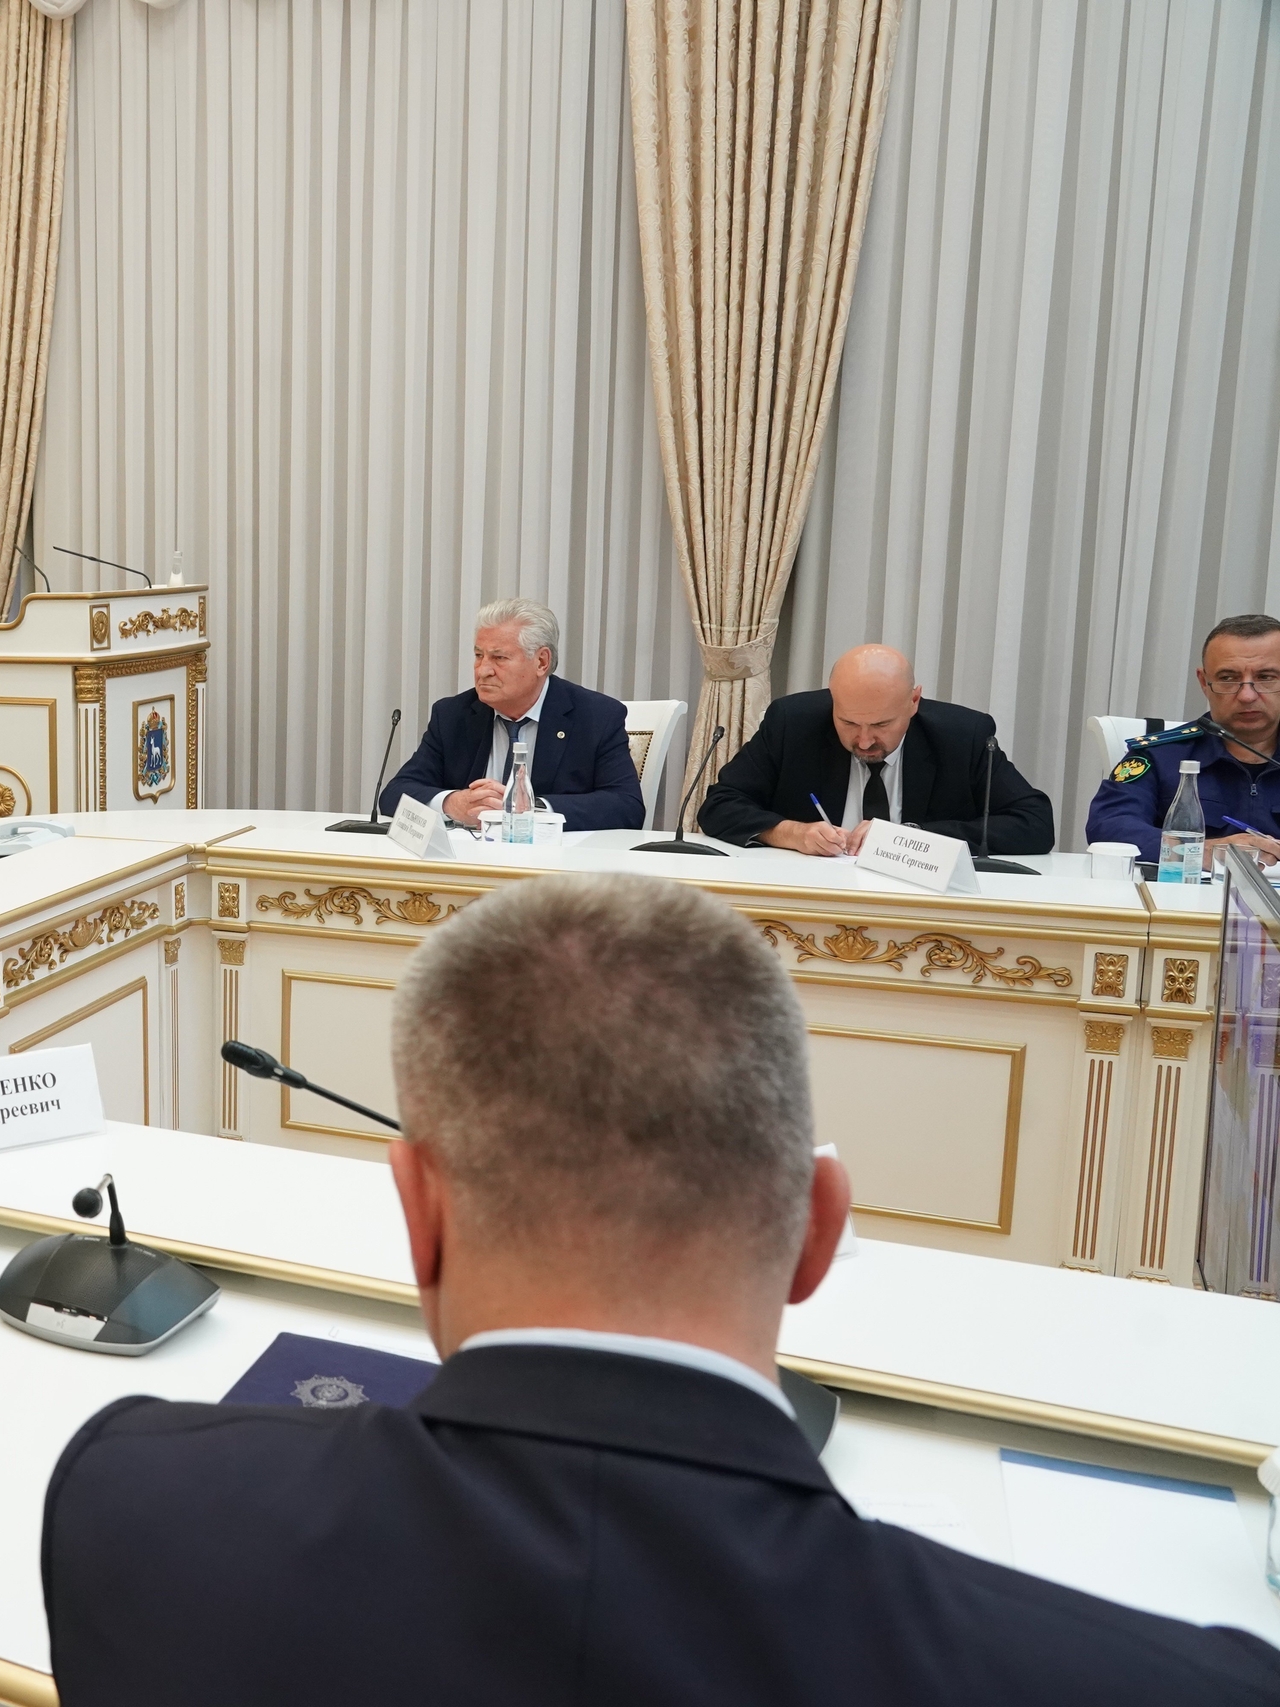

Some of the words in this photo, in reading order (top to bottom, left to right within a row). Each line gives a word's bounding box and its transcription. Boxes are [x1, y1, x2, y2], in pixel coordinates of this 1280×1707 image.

[893, 836, 931, 853] СТАРЦЕВ
[873, 847, 901, 861] Алексей
[901, 853, 939, 873] Сергеевич
